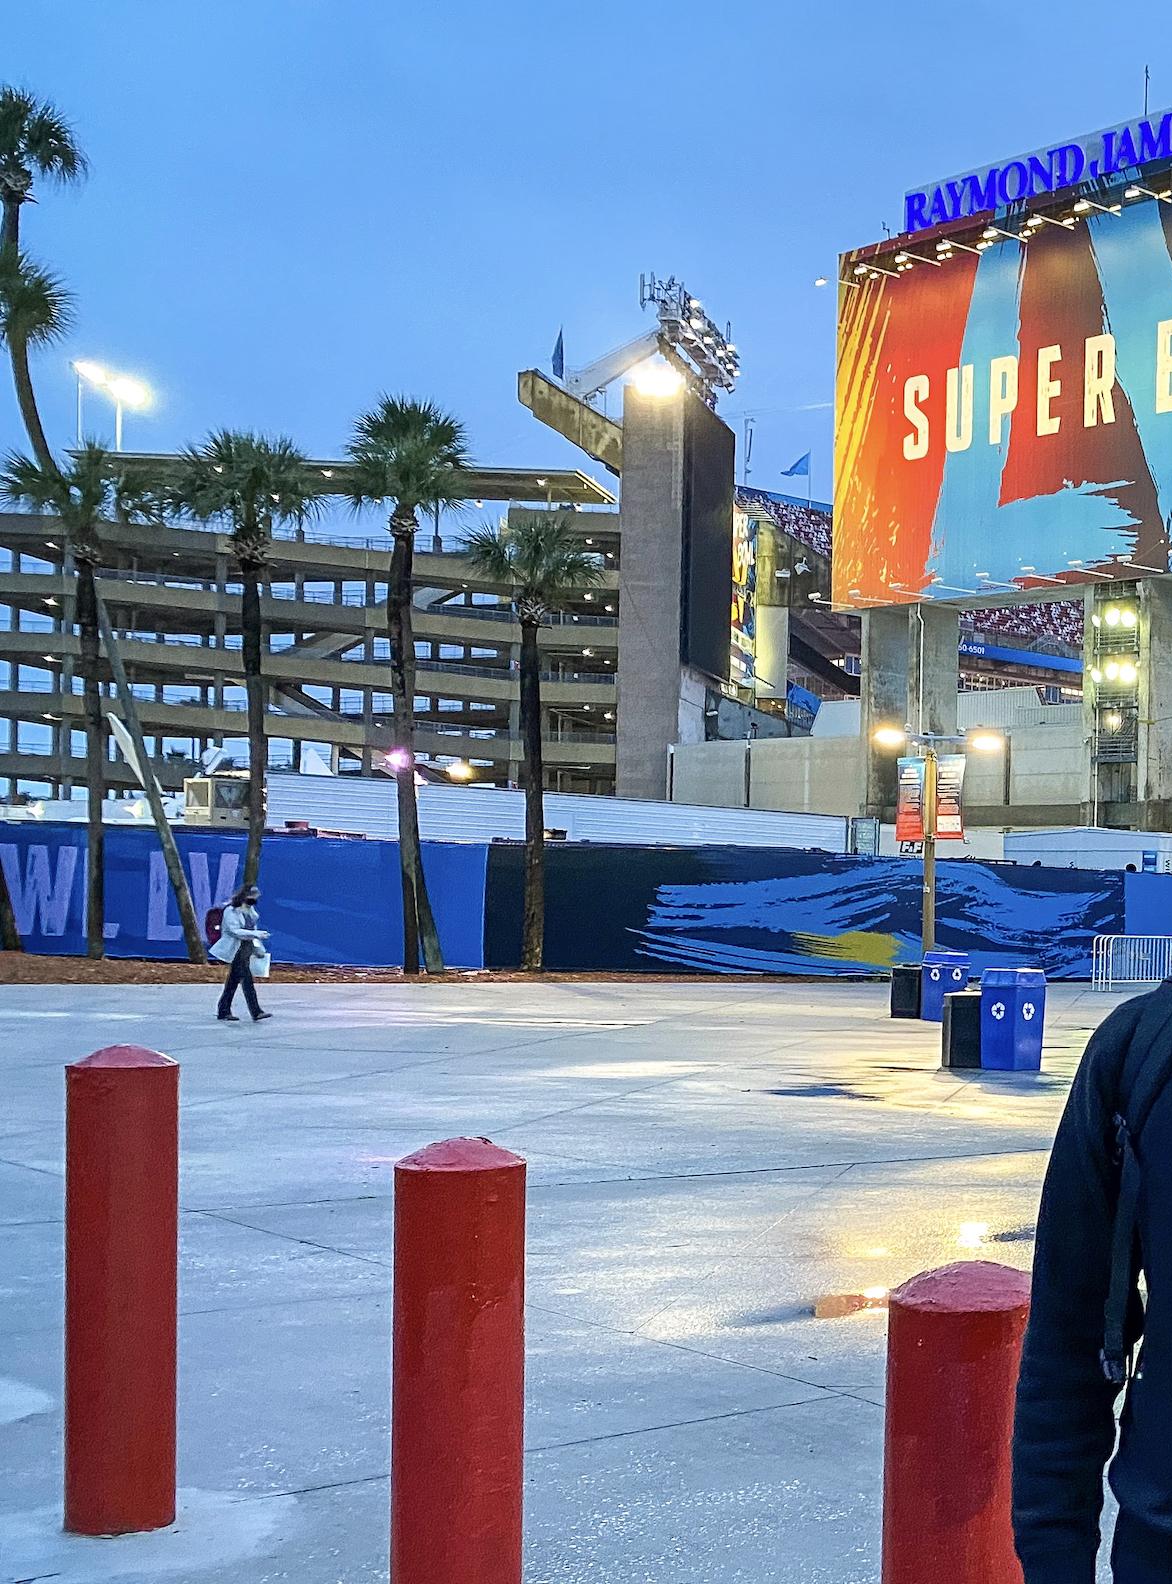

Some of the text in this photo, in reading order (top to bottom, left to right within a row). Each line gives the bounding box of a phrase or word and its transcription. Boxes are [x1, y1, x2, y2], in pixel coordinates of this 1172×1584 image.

[905, 144, 1086, 235] RAYMOND
[902, 333, 1117, 461] SUPER
[147, 850, 240, 942] LV
